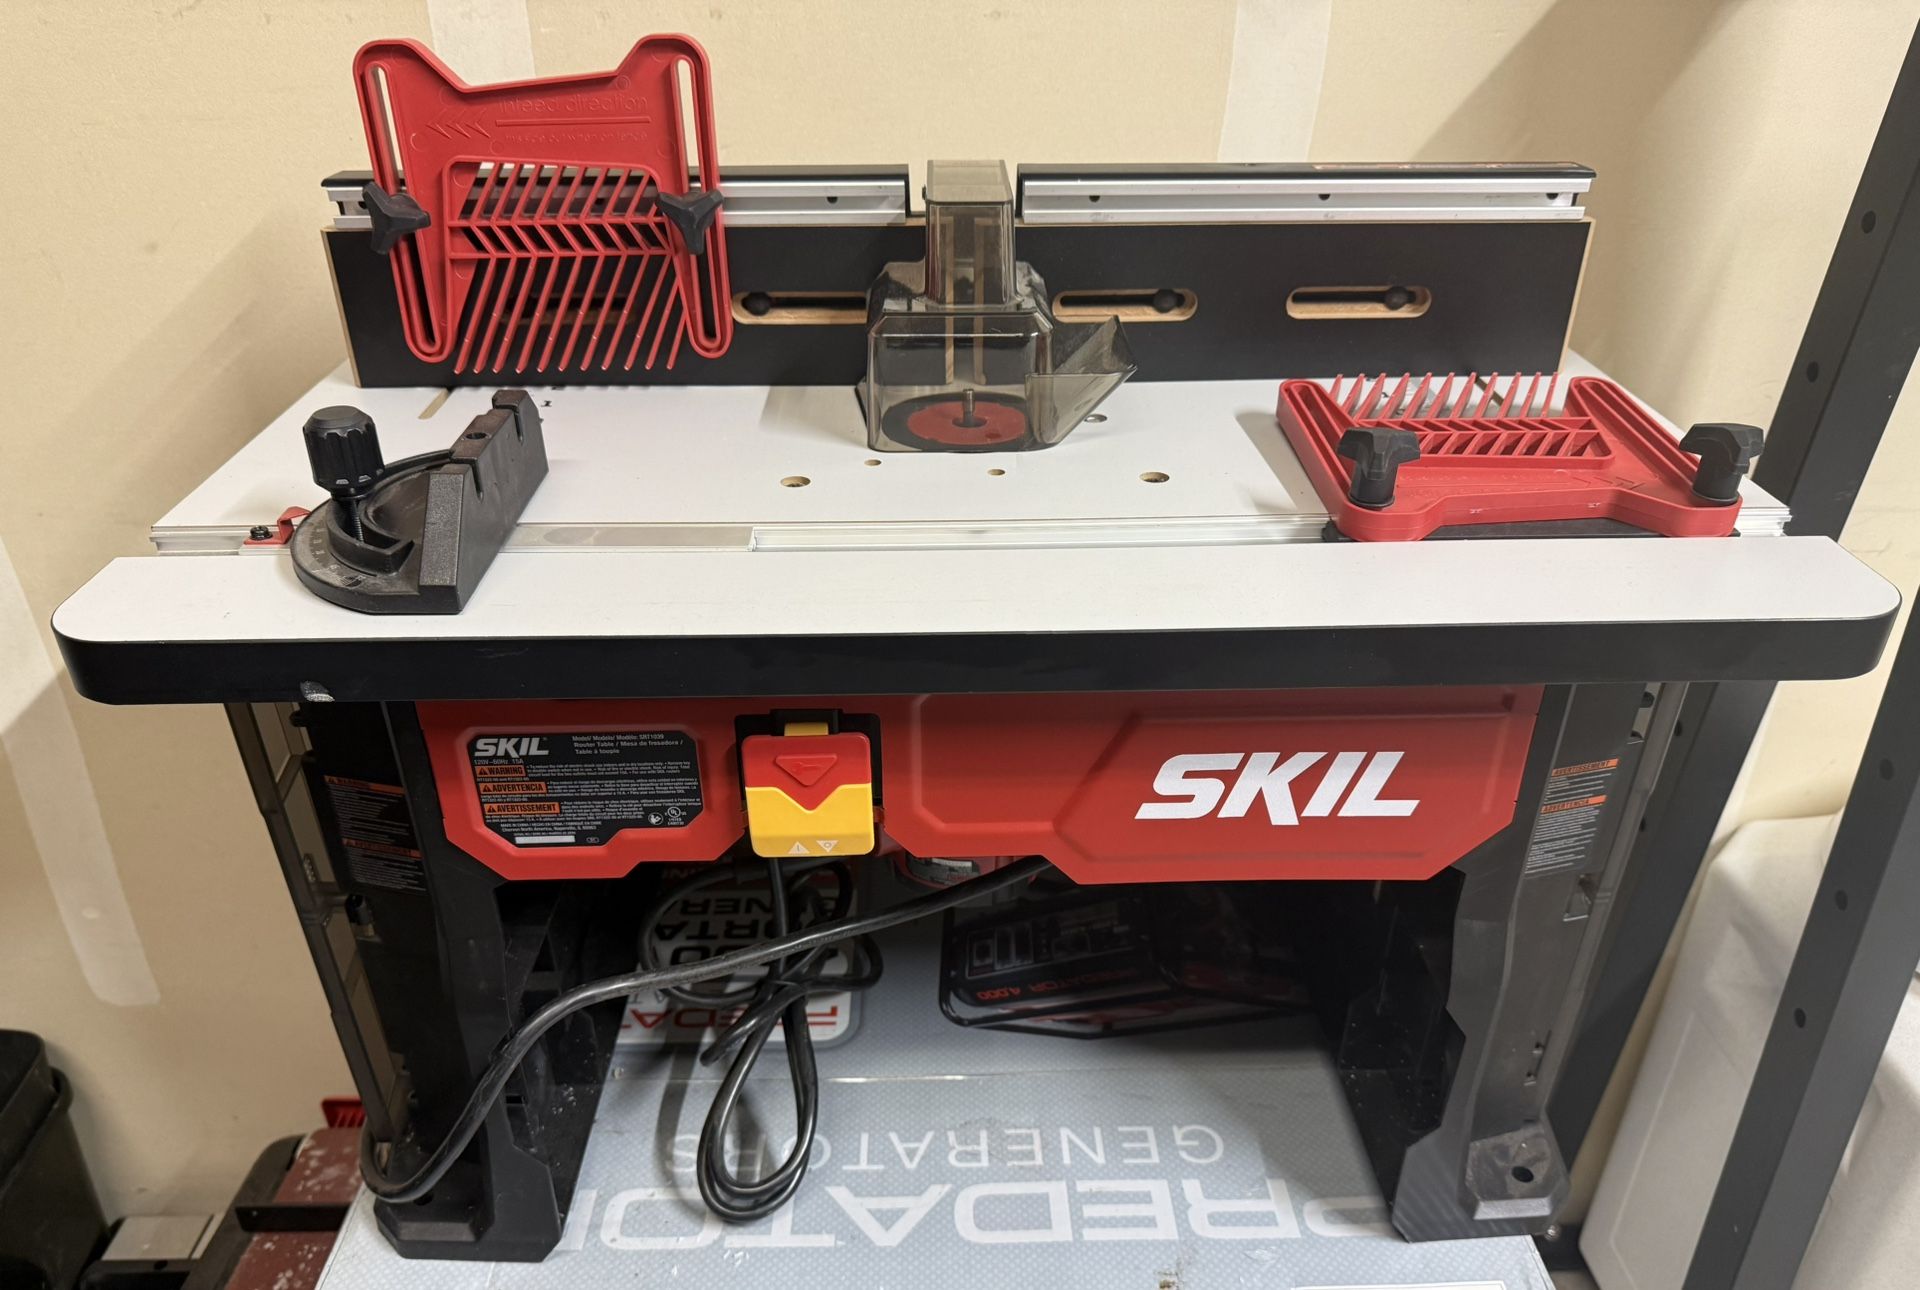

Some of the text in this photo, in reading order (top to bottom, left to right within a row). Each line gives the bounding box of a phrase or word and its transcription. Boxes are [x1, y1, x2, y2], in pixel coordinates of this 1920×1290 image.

[564, 94, 650, 113] direction
[474, 737, 549, 758] SKIL
[487, 766, 522, 775] WARNING
[492, 783, 543, 792] ADVERTENCIA
[1135, 751, 1420, 825] SKIL
[497, 803, 556, 813] AVERTISSEMENT
[561, 1179, 1395, 1251] PREDATO
